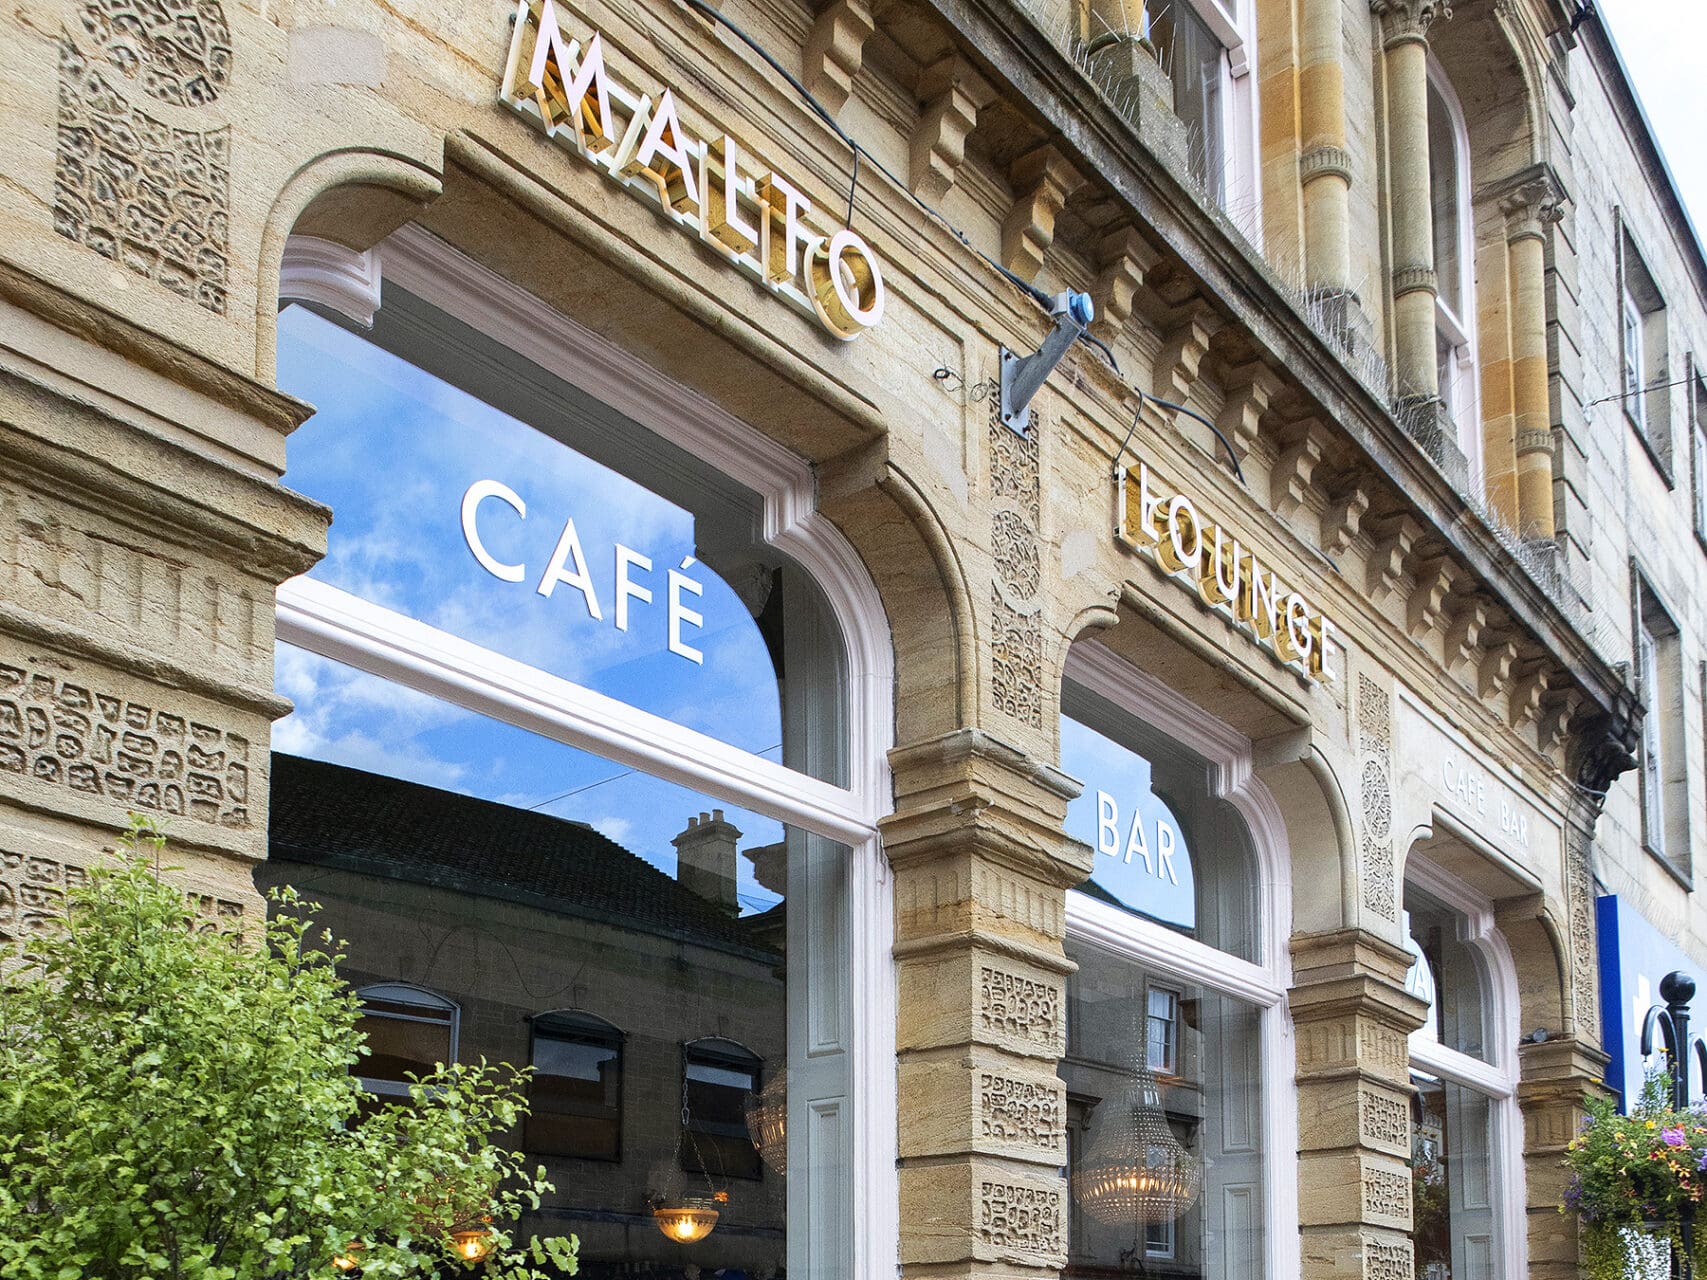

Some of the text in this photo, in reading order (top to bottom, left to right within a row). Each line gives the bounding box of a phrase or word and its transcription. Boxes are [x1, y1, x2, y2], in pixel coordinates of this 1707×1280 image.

[502, 0, 884, 340] MALTO
[461, 479, 703, 665] CAFÉ
[1118, 462, 1335, 686] LOUNGE
[1097, 790, 1178, 886] BAR
[1501, 799, 1528, 848] BAR
